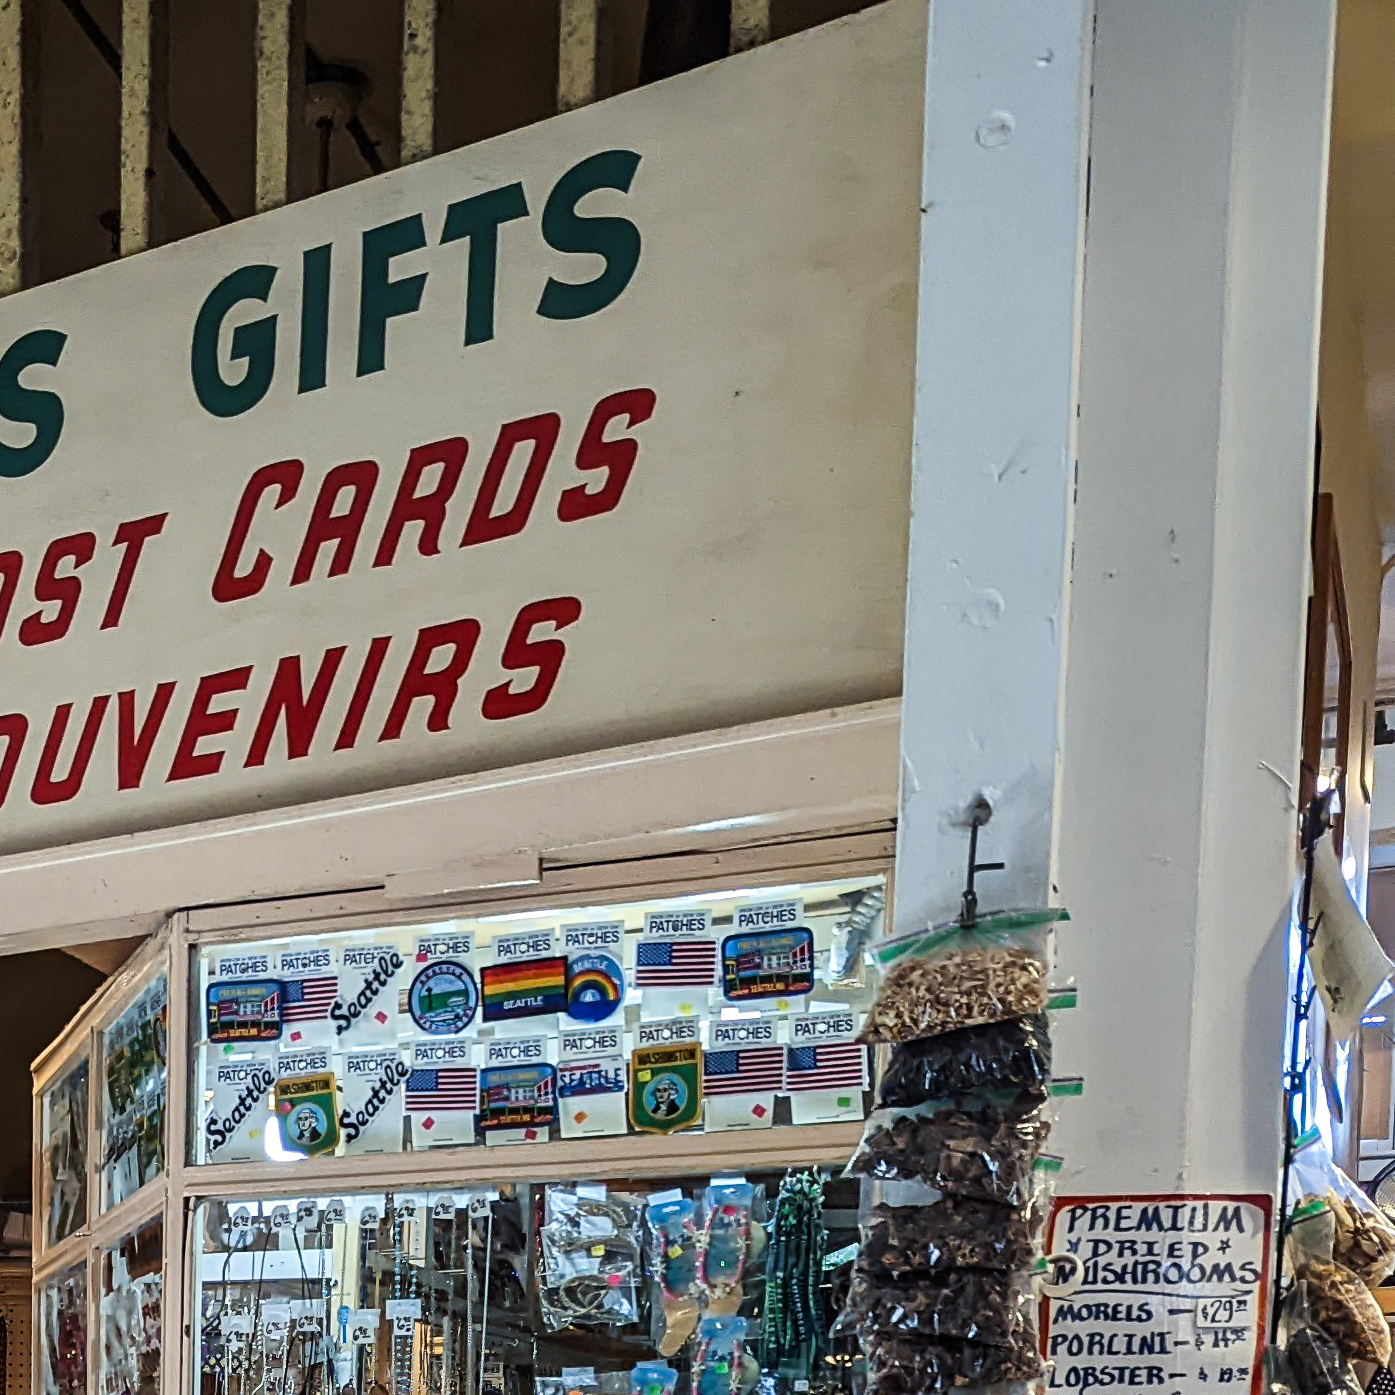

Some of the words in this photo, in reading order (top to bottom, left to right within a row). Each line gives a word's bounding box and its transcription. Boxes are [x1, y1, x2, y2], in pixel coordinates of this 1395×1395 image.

[191, 149, 643, 418] GIFTS
[213, 388, 656, 604] CARDS
[649, 919, 705, 933] PATCHES
[738, 909, 796, 927] PATCHES
[418, 940, 470, 955] PATCHES
[497, 938, 551, 957] PATCHES
[565, 931, 619, 947] PATCHES
[219, 960, 268, 976] PATCHES
[281, 954, 330, 971] PATCHES
[330, 952, 404, 1036] Seattle
[639, 1028, 695, 1044] PATCHES
[715, 1028, 772, 1042] PATCHES
[795, 1019, 853, 1036] PATCHES
[489, 1043, 542, 1060] PATCHES
[563, 1035, 617, 1051] PATCHES
[415, 1046, 466, 1061] PATCHES
[278, 1057, 327, 1073] PATCHES
[206, 1070, 276, 1151] Seattle
[340, 1061, 409, 1144] Seattle
[1066, 1203, 1245, 1235] PREMIUM
[1086, 1239, 1210, 1259] DRIED
[1055, 1261, 1260, 1287] MUSHROOMS
[1053, 1302, 1153, 1324] MORELS
[1049, 1331, 1172, 1356] PORCINI
